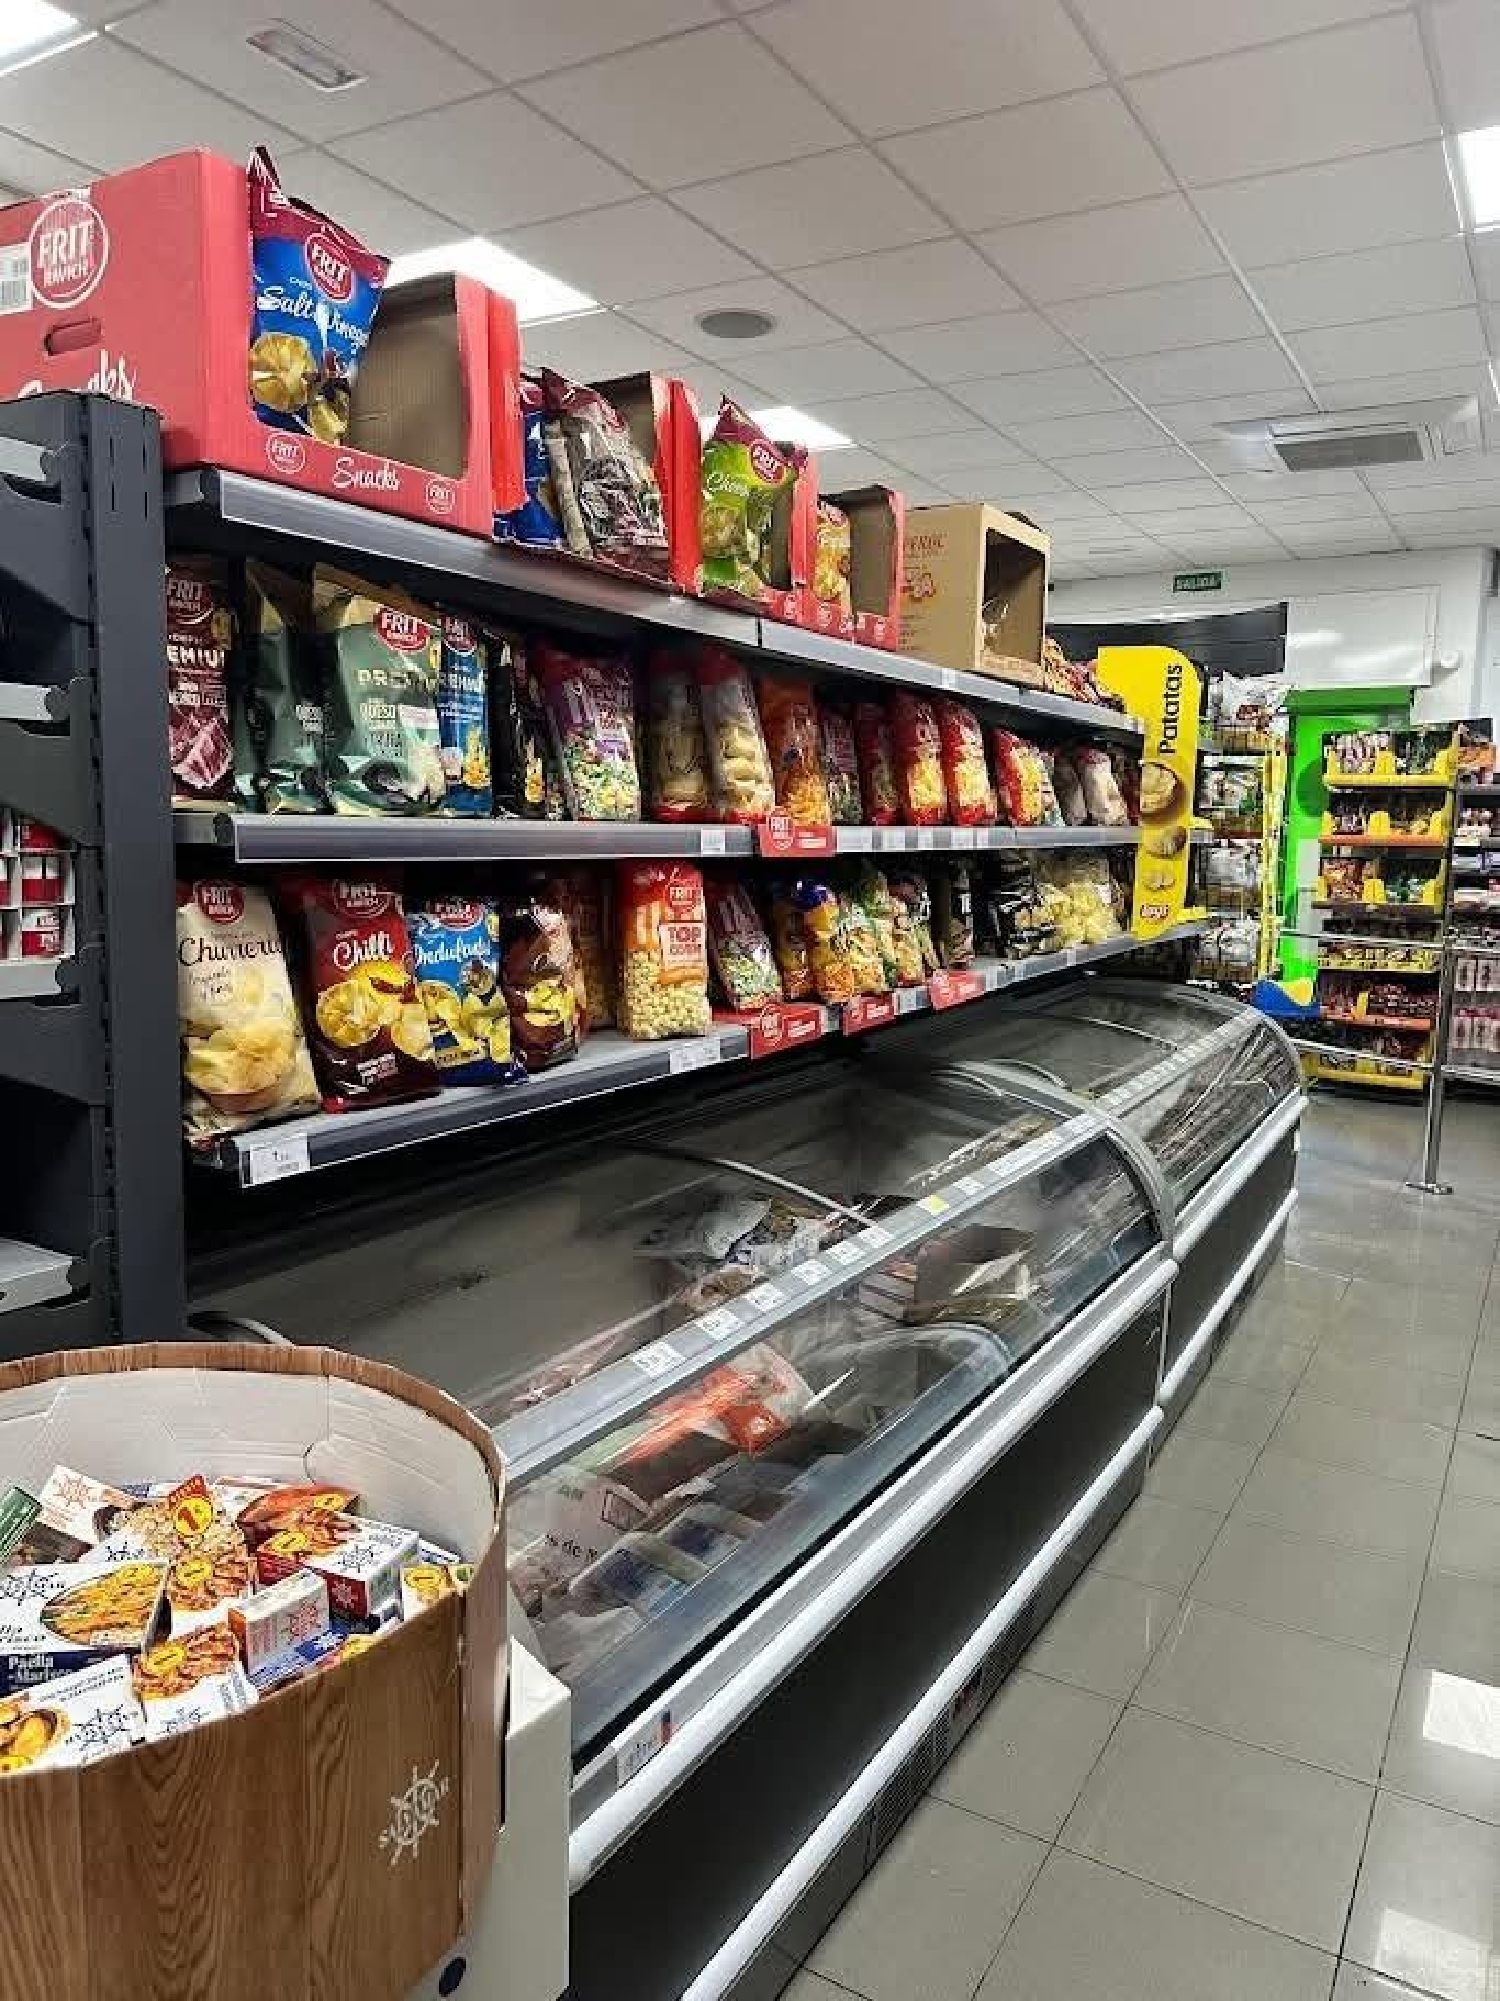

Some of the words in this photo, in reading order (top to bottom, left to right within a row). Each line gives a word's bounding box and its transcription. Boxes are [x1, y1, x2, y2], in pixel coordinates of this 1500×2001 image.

[37, 219, 95, 268] FRIT
[381, 611, 419, 635] FRIT
[1159, 664, 1183, 754] Patatas
[667, 926, 702, 943] TOP
